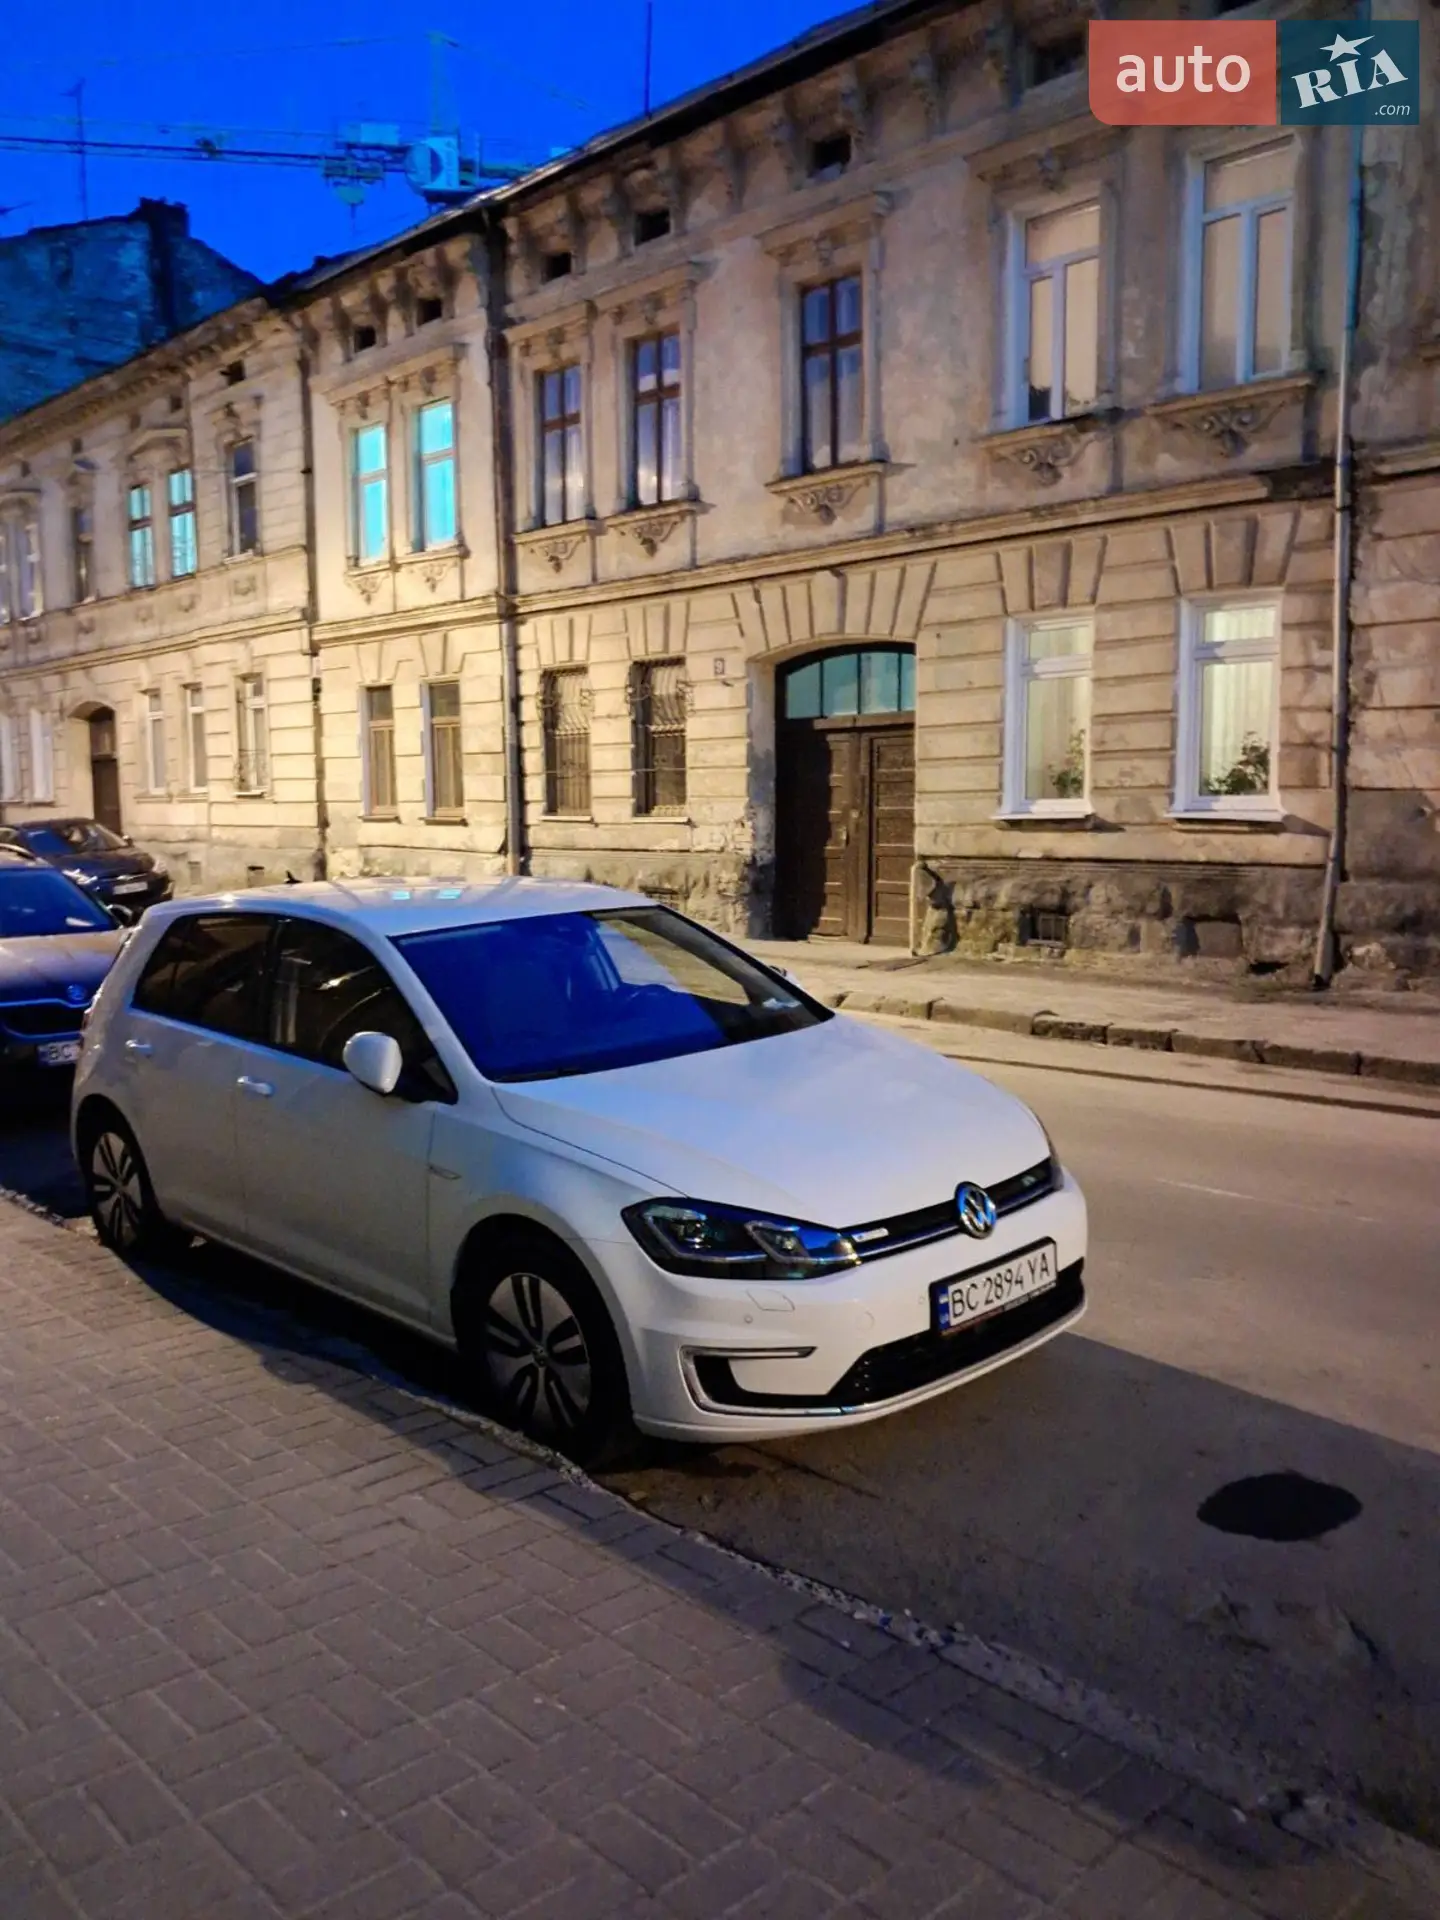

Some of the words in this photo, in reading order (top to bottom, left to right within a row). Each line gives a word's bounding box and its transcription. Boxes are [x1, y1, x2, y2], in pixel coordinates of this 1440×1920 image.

[951, 1283, 979, 1319] BC
[983, 1262, 1025, 1306] 2894
[1027, 1252, 1051, 1284] YA
